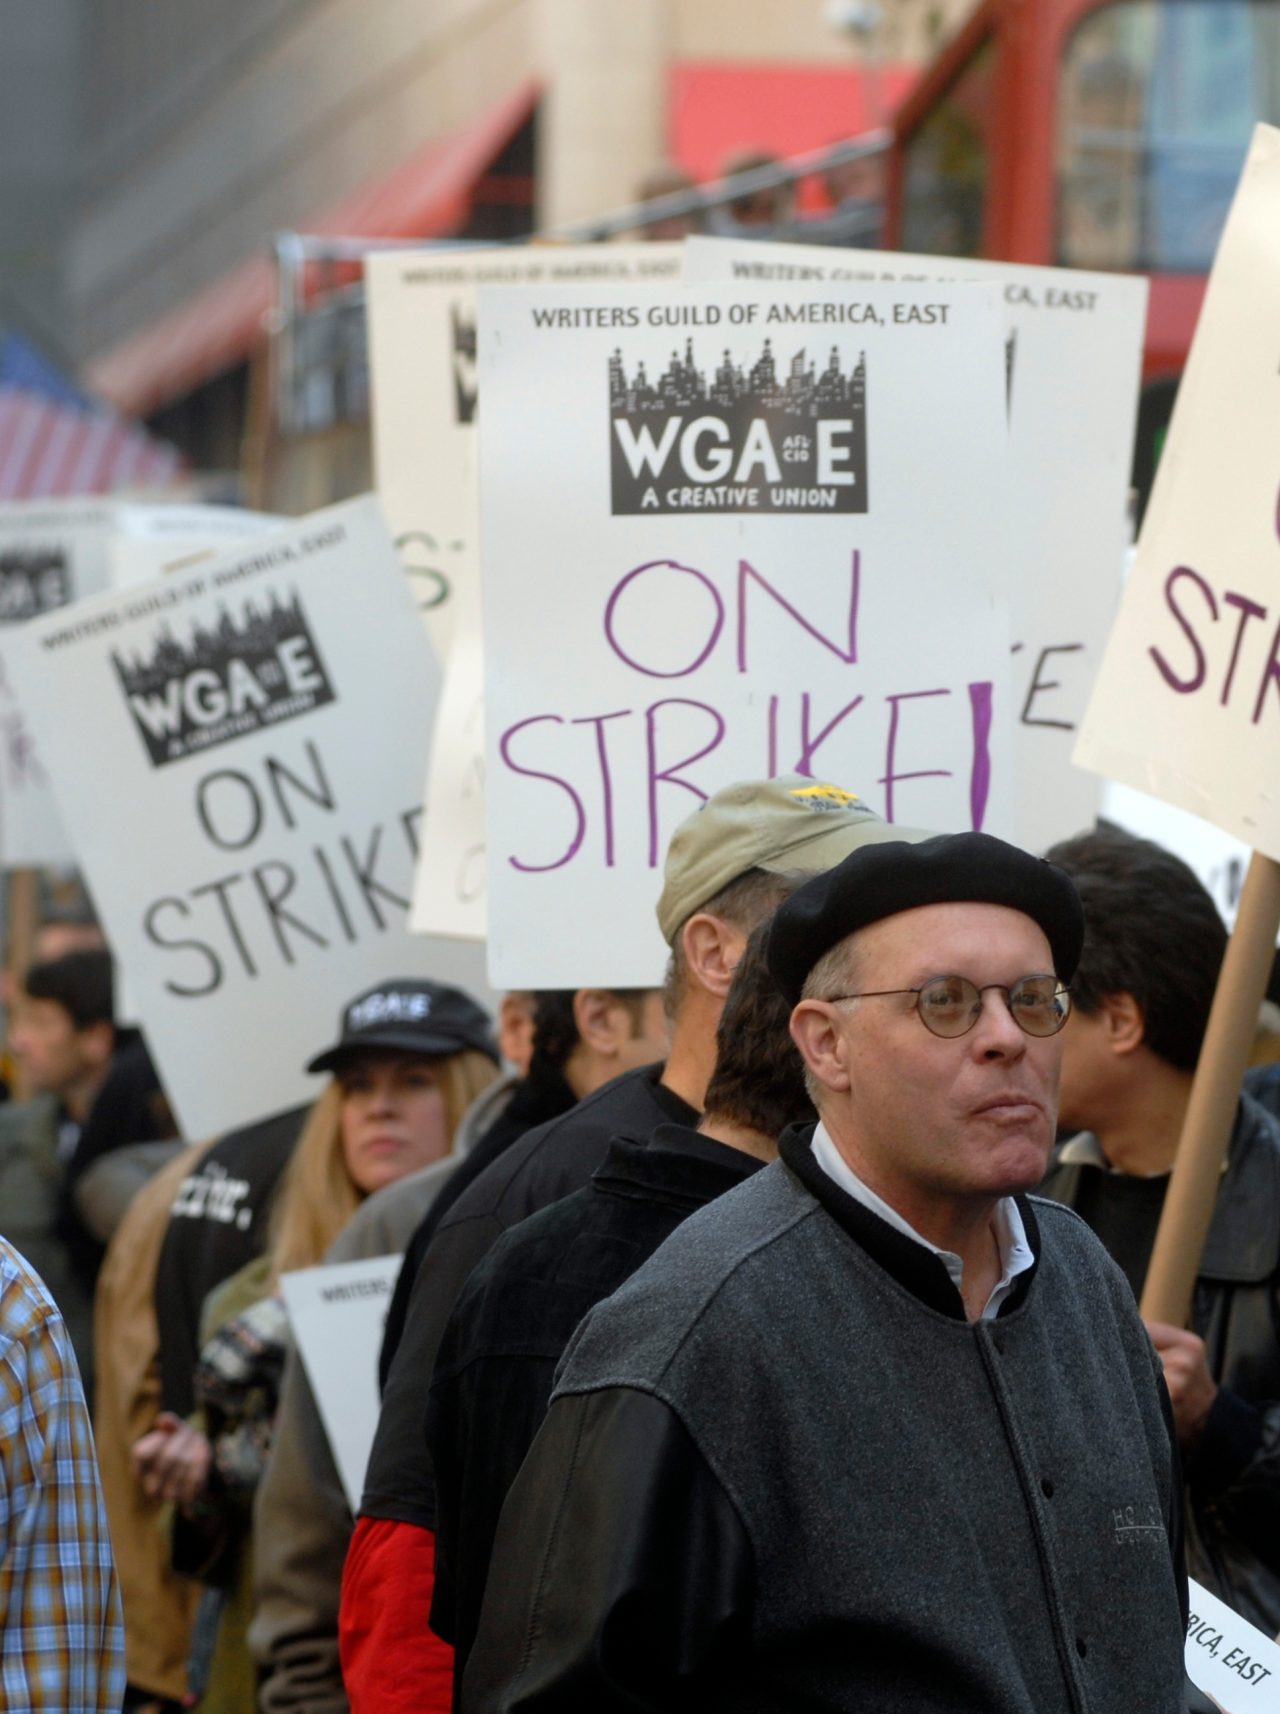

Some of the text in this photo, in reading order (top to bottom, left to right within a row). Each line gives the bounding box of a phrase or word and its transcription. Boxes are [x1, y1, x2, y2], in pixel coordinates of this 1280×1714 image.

[532, 302, 950, 328] WRITERS GUILD OF AMERICA, EAST
[1044, 287, 1098, 312] EAST
[641, 487, 837, 509] A CREATIVE UNION
[604, 549, 861, 678] ON
[195, 738, 336, 851] ON
[1187, 1609, 1272, 1686] RICA, EAST
